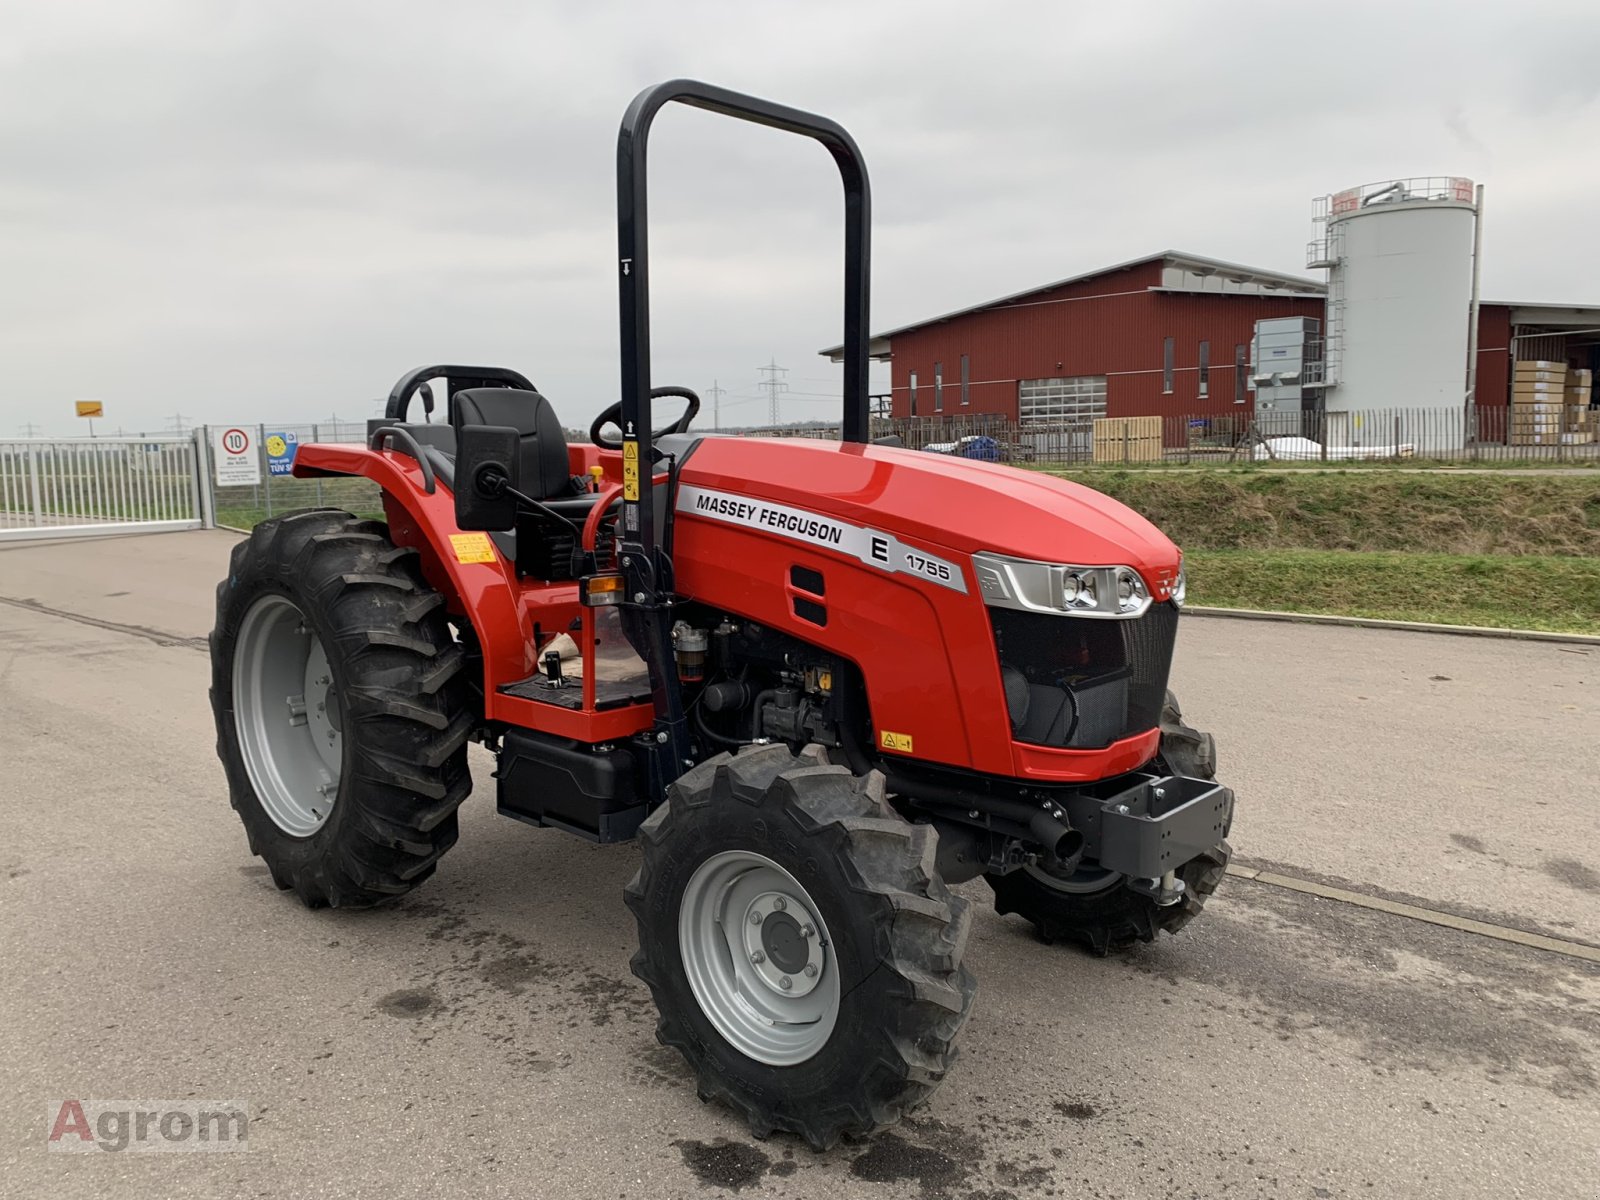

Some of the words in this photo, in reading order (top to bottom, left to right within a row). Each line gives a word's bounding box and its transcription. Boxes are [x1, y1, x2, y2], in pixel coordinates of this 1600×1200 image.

[229, 435, 242, 448] 10
[270, 463, 285, 473] TÜV
[696, 494, 756, 521] MASSEY
[759, 508, 843, 544] FERGUSON
[871, 537, 888, 562] E
[906, 554, 951, 580] 1755
